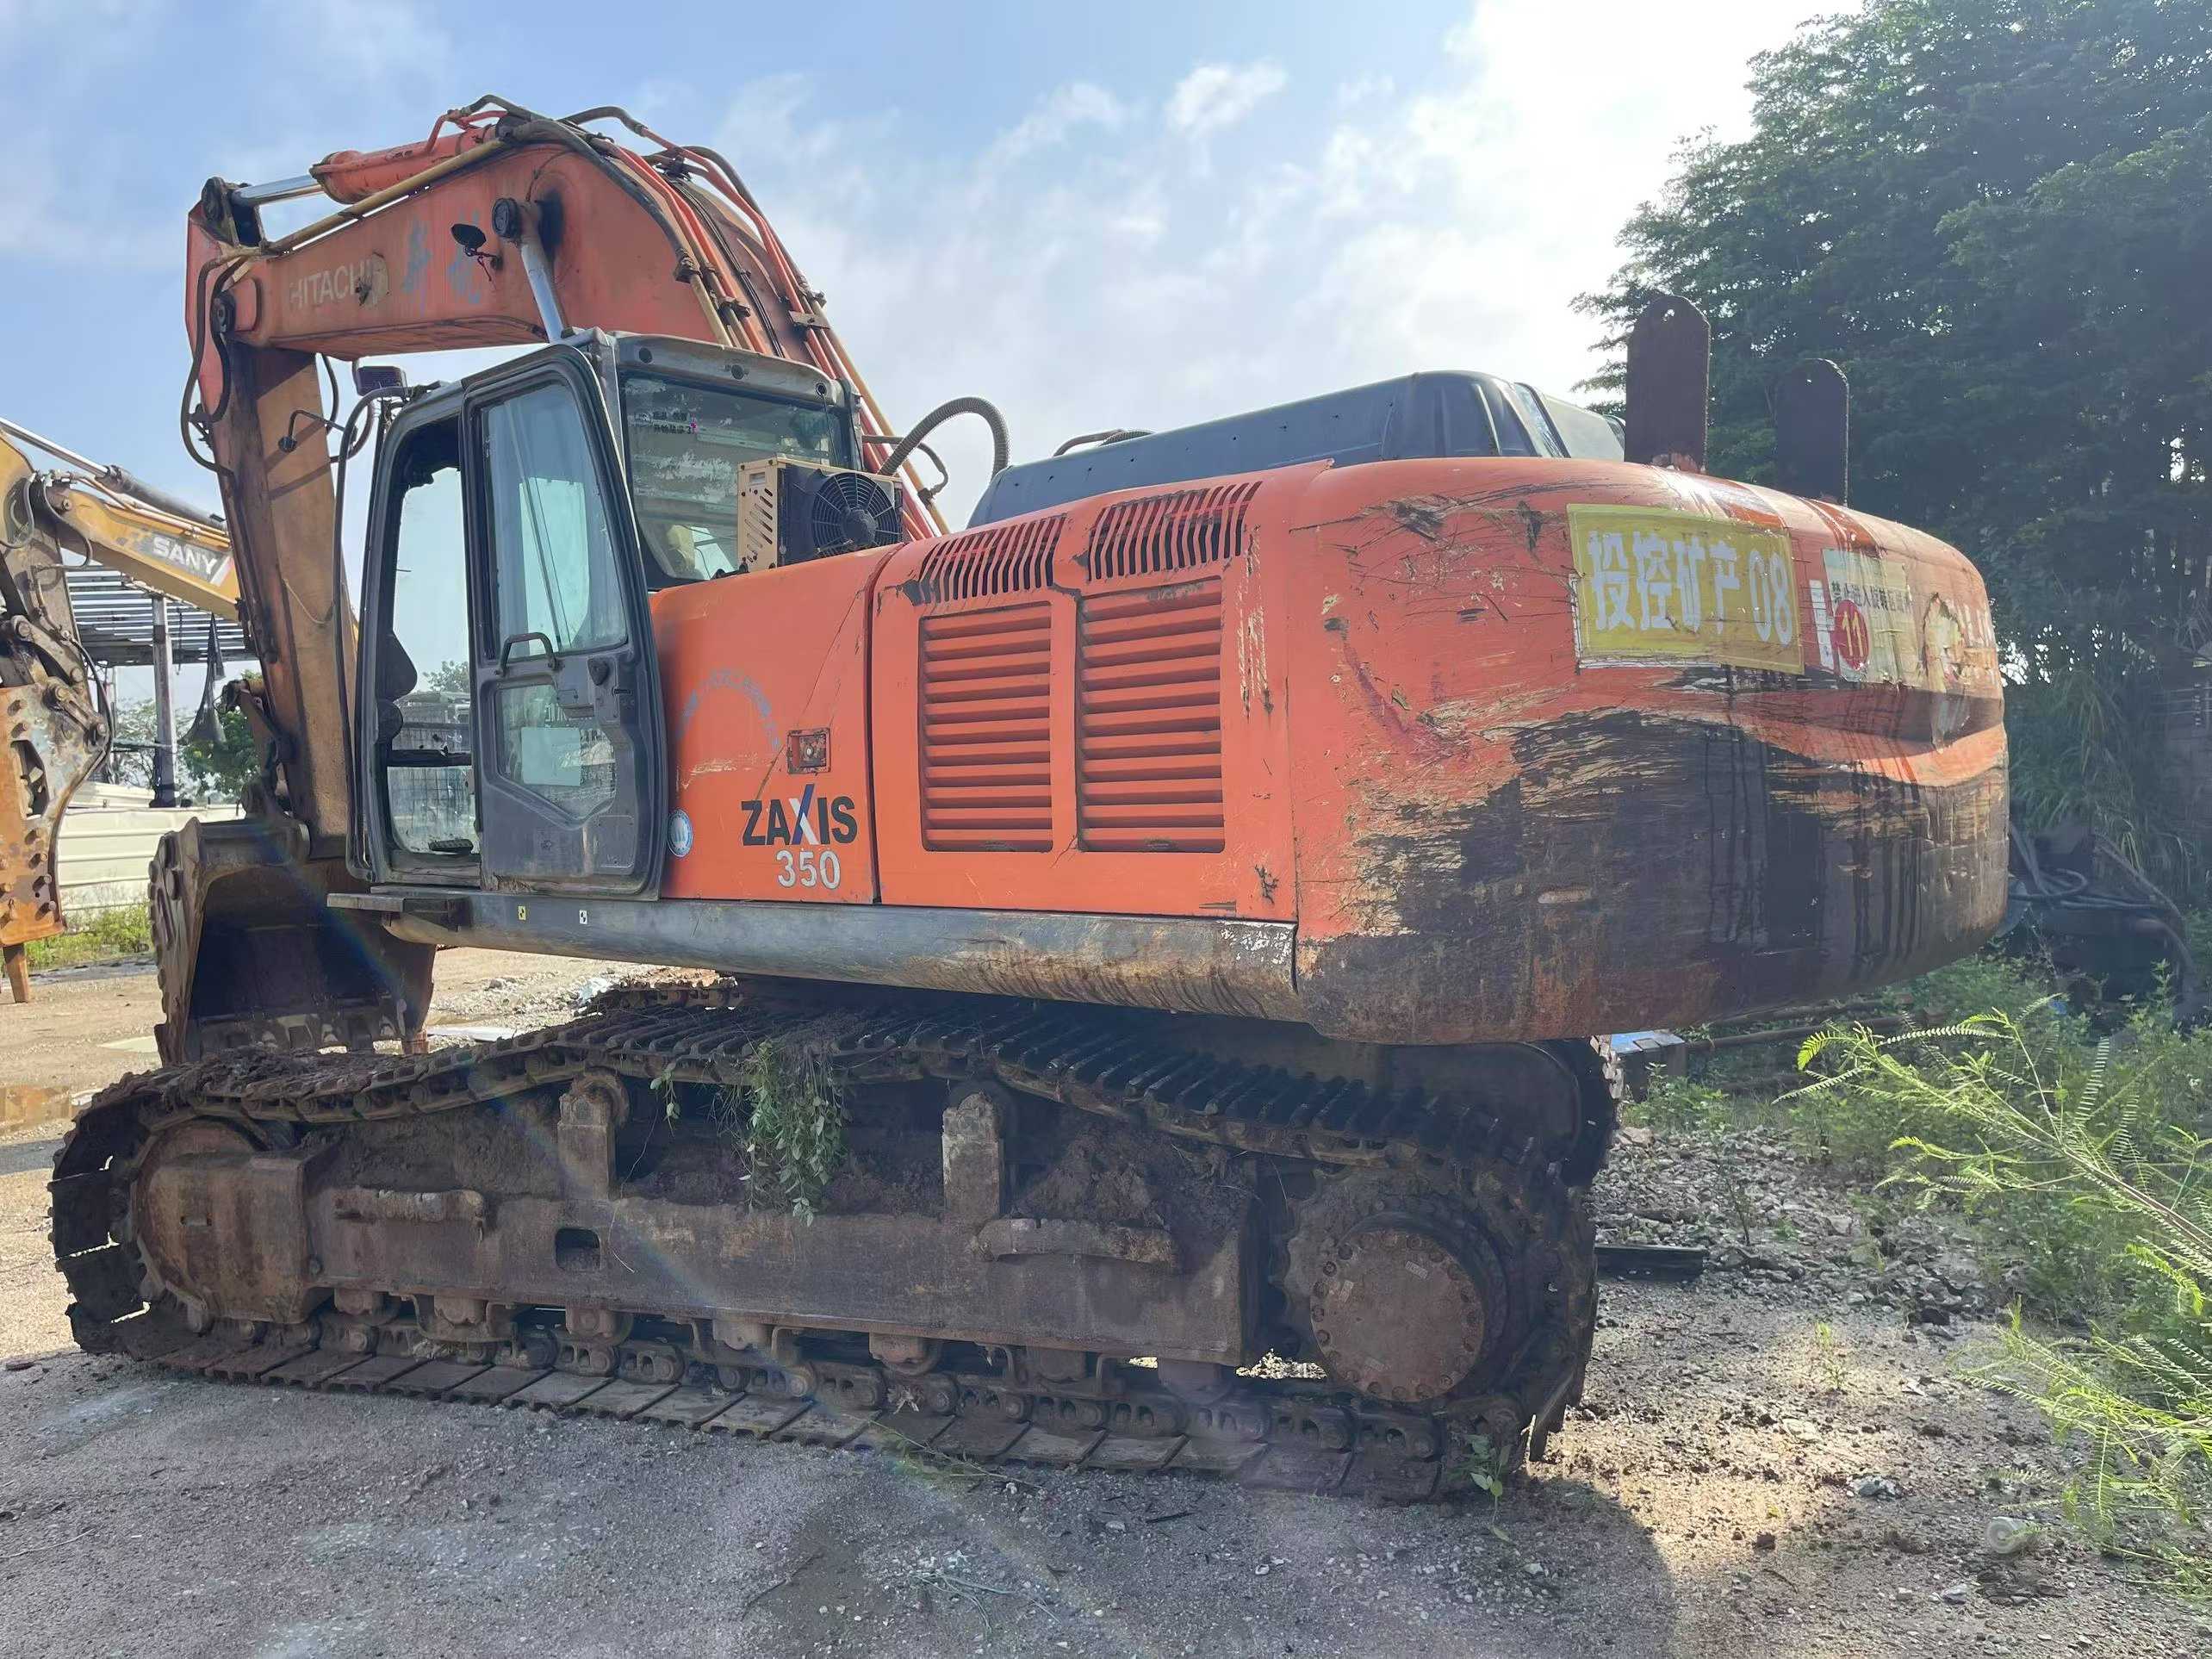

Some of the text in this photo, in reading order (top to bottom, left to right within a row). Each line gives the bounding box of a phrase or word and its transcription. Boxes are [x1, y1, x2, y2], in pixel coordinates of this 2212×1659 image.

[152, 536, 217, 575] SANY
[1588, 530, 1741, 635] 投控矿产
[1749, 550, 1793, 648] 08
[1842, 610, 1864, 658] 11
[741, 783, 858, 846] ZAXIS
[776, 848, 842, 890] 350
